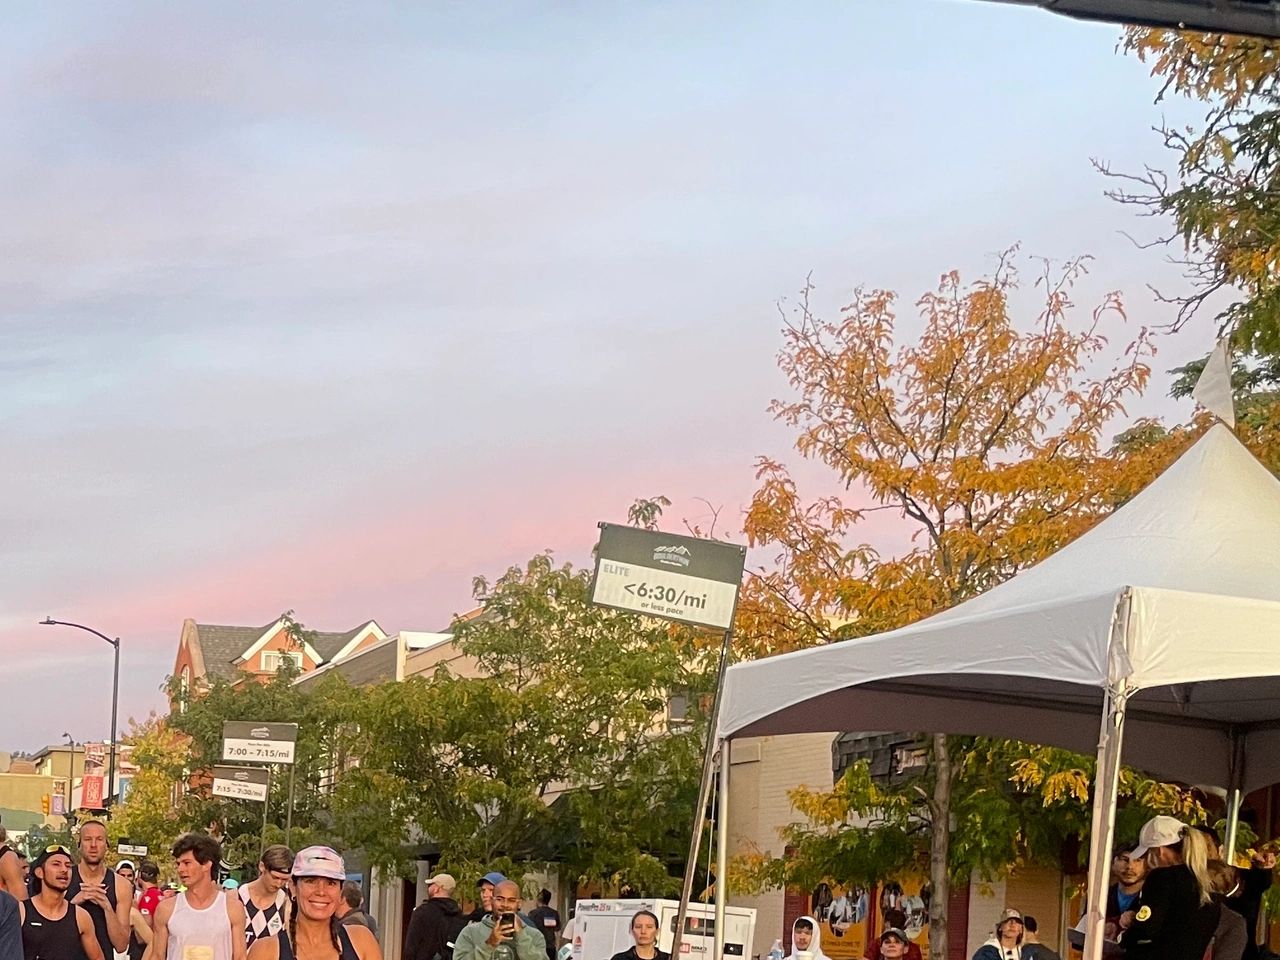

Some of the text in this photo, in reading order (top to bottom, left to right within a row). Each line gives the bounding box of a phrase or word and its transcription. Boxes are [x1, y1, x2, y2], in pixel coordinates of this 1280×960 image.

[604, 564, 631, 577] ELITE
[624, 583, 707, 609] <6:30/mi
[651, 602, 665, 611] less
[666, 607, 683, 615] pace
[256, 749, 289, 758] 7:15/mi
[237, 788, 262, 797] 7:30/mi
